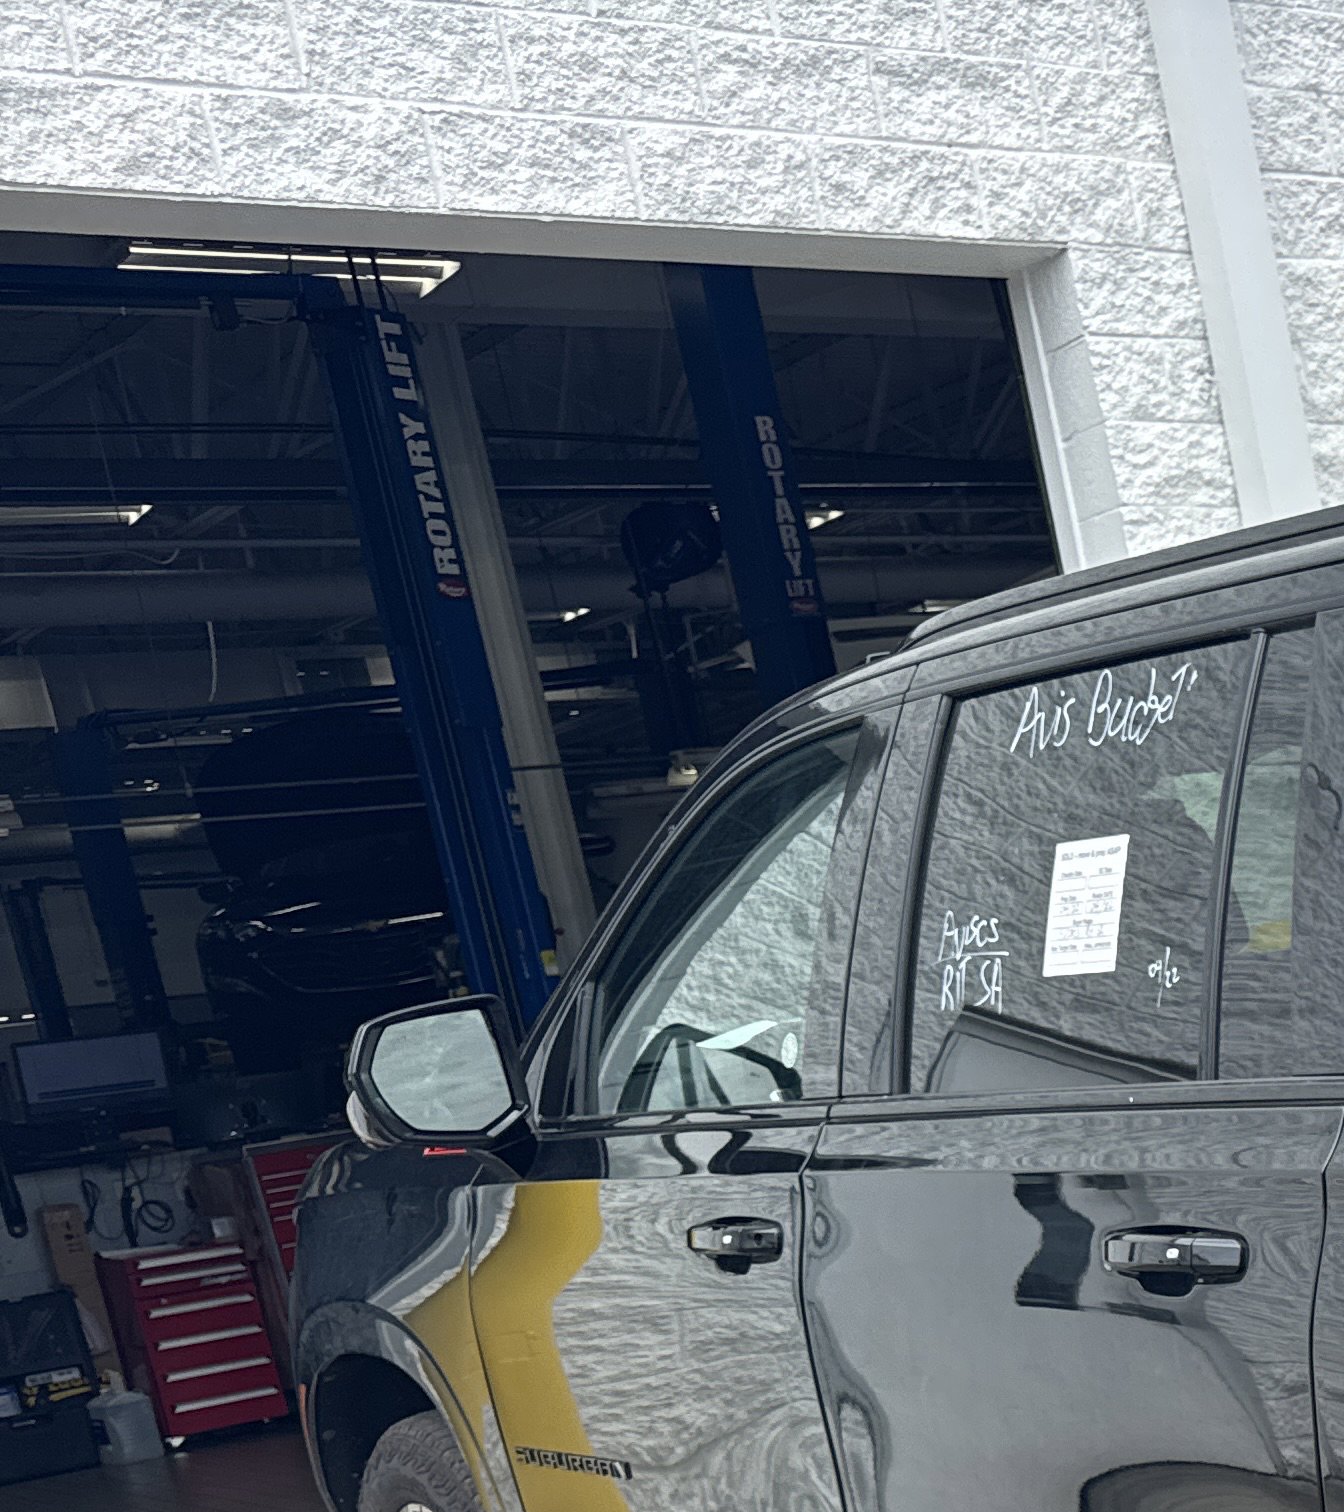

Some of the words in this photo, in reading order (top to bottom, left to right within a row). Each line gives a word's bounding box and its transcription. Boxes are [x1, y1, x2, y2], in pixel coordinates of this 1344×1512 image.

[374, 314, 422, 403] LIFT
[398, 411, 461, 576] ROTARY
[754, 415, 802, 578] ROTARY
[1009, 686, 1076, 758] Avis
[514, 1446, 633, 1481] SUBURBAN
